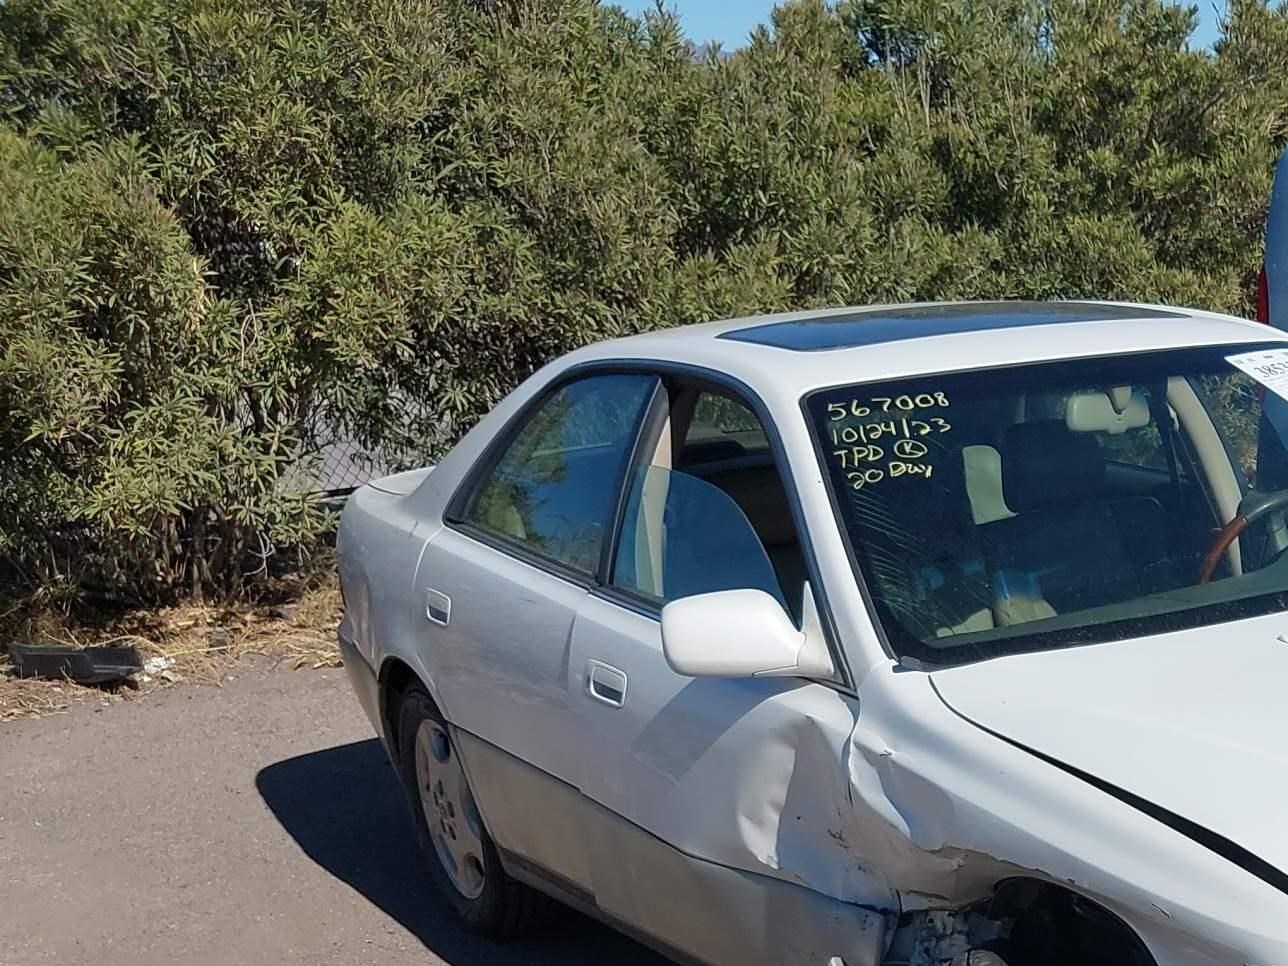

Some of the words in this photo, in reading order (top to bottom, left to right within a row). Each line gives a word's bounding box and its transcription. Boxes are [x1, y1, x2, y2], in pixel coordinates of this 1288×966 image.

[828, 391, 950, 420] 567008
[832, 444, 885, 469] TPD
[847, 469, 885, 490] 20
